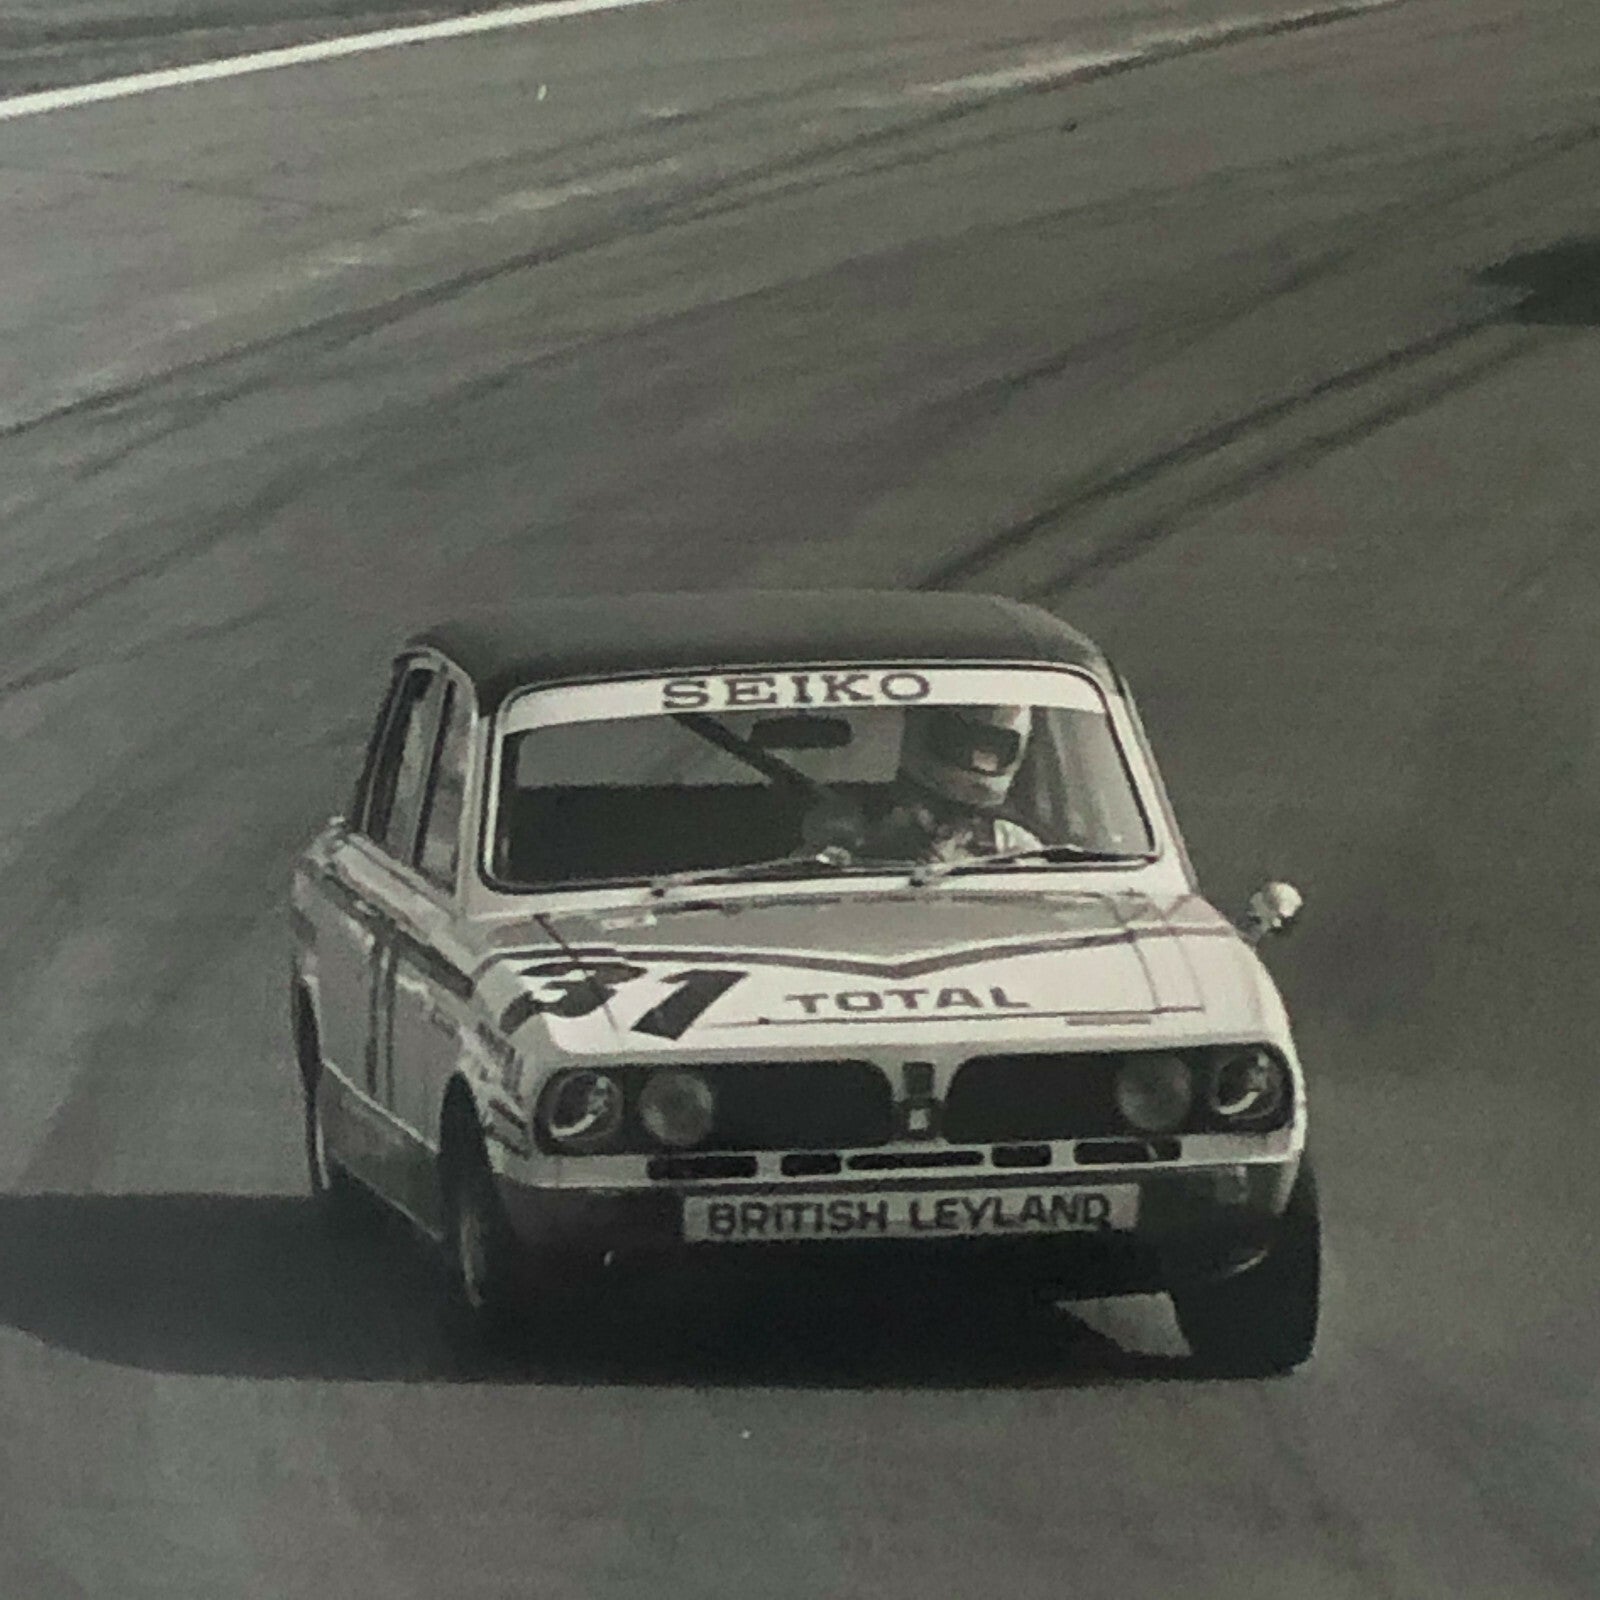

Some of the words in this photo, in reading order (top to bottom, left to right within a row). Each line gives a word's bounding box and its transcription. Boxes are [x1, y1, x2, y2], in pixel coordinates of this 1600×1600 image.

[662, 673, 930, 708] SEIKO
[500, 961, 748, 1040] 31
[785, 986, 1031, 1014] TOTAL
[708, 1200, 888, 1236] BRITISH
[908, 1193, 1112, 1231] LEYLAND
